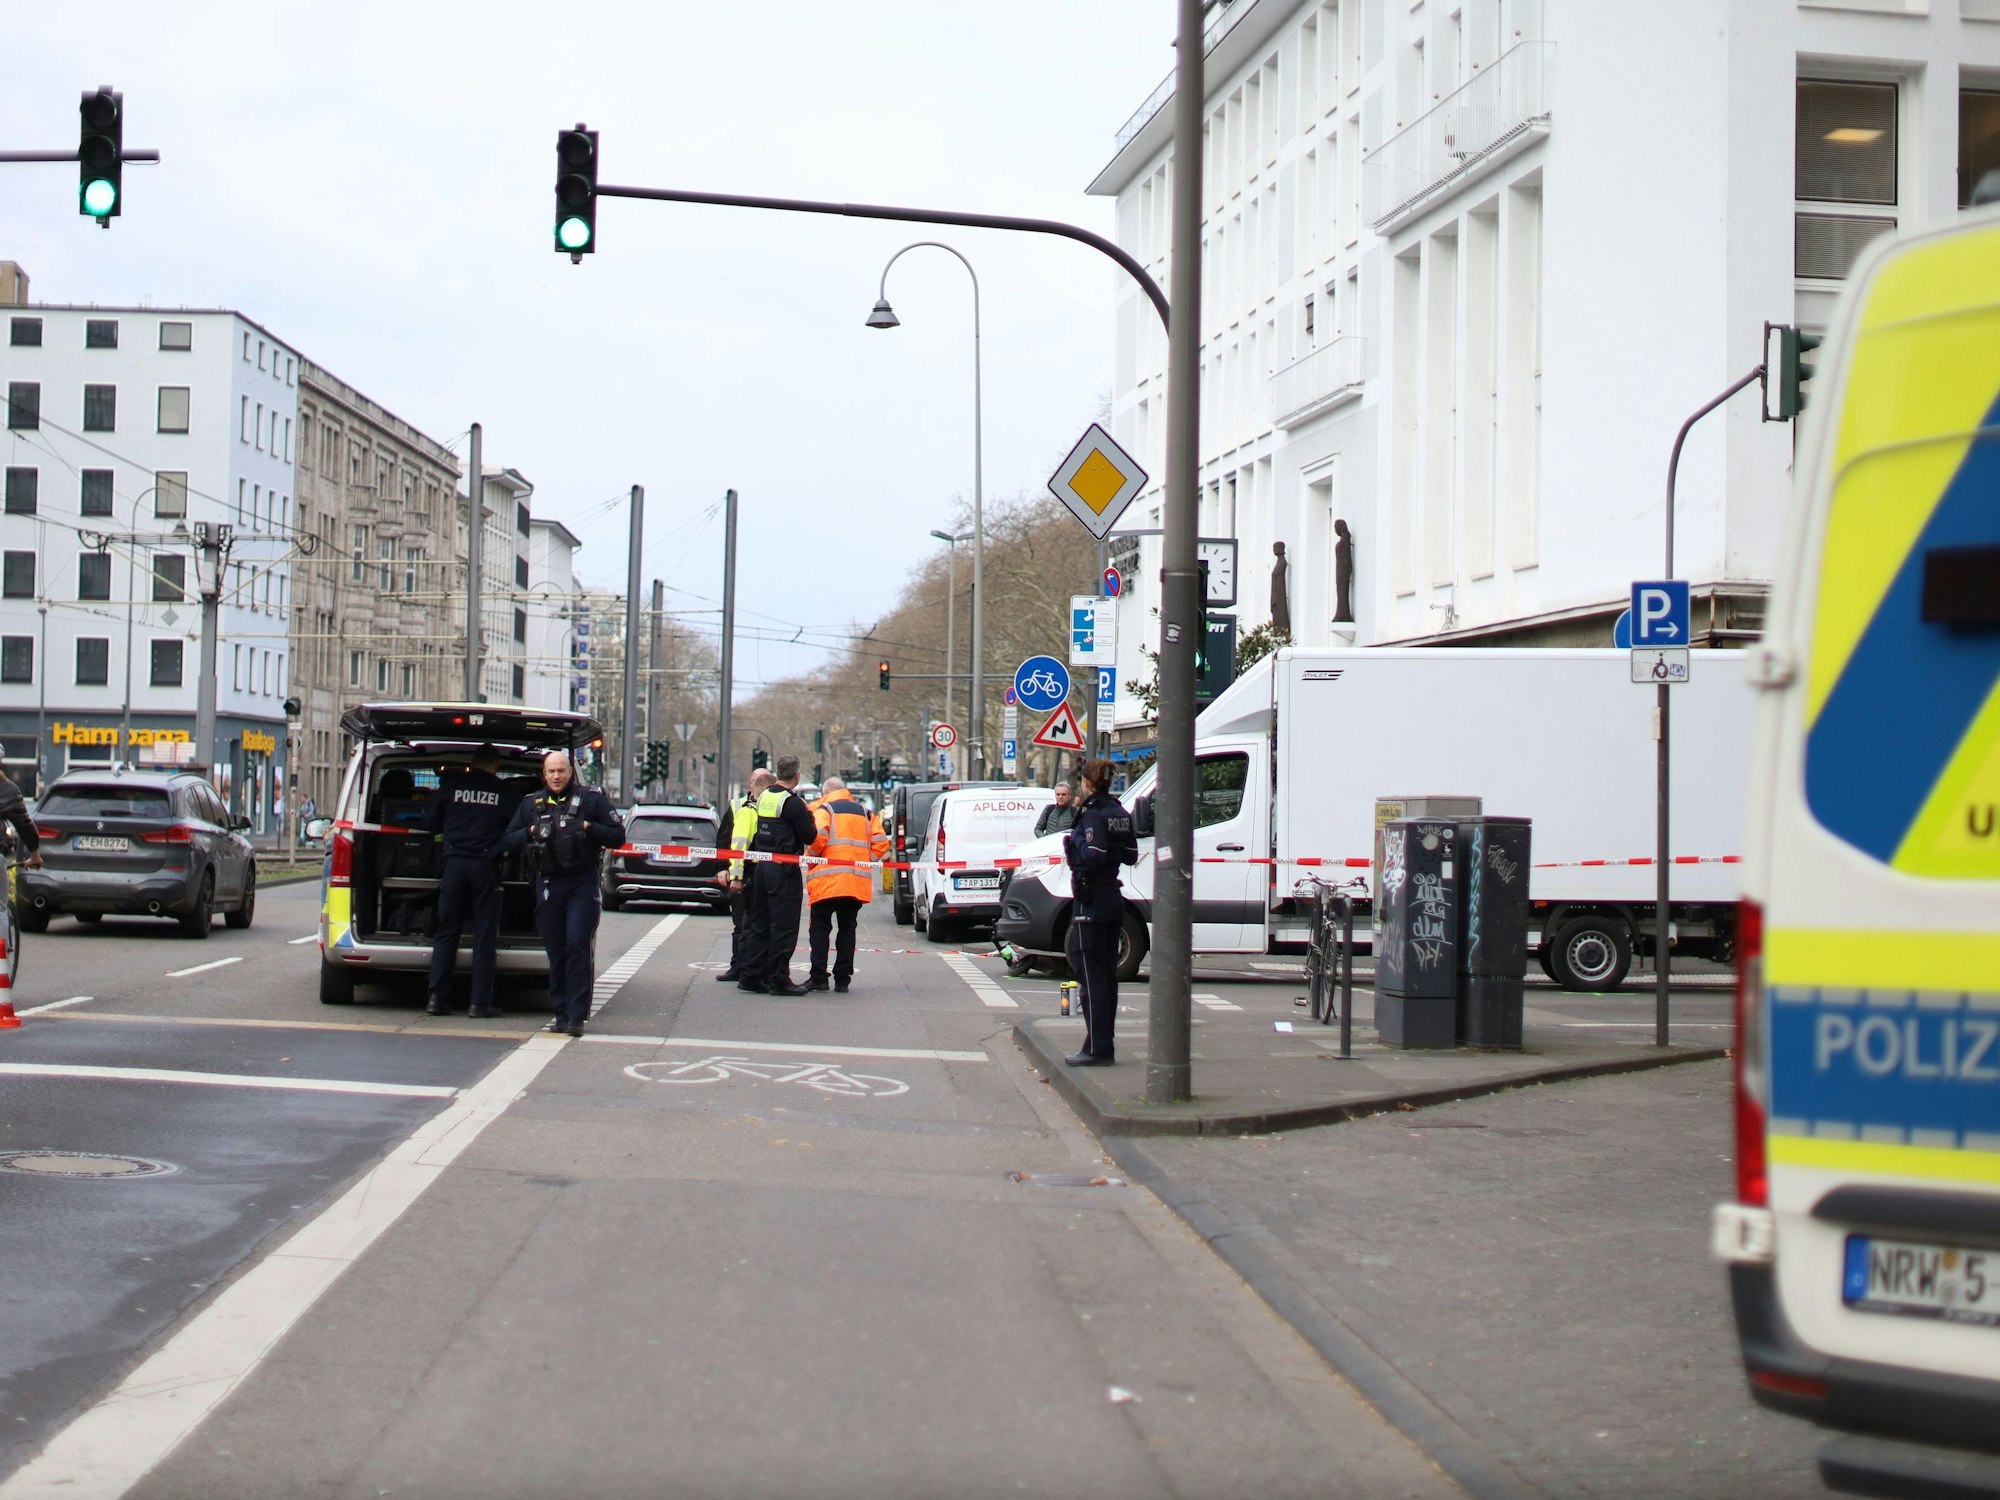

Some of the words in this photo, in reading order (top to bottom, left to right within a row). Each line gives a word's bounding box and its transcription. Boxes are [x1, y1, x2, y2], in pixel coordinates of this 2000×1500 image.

[1640, 589, 1671, 638] P
[1099, 671, 1110, 699] P
[938, 731, 951, 741] 30
[1005, 742, 1013, 757] P
[454, 789, 499, 805] POLIZEI
[973, 802, 1035, 811] APLEONA
[980, 878, 998, 886] 1317
[1814, 1013, 2000, 1078] POLIZ
[1872, 1248, 1940, 1297] NRW
